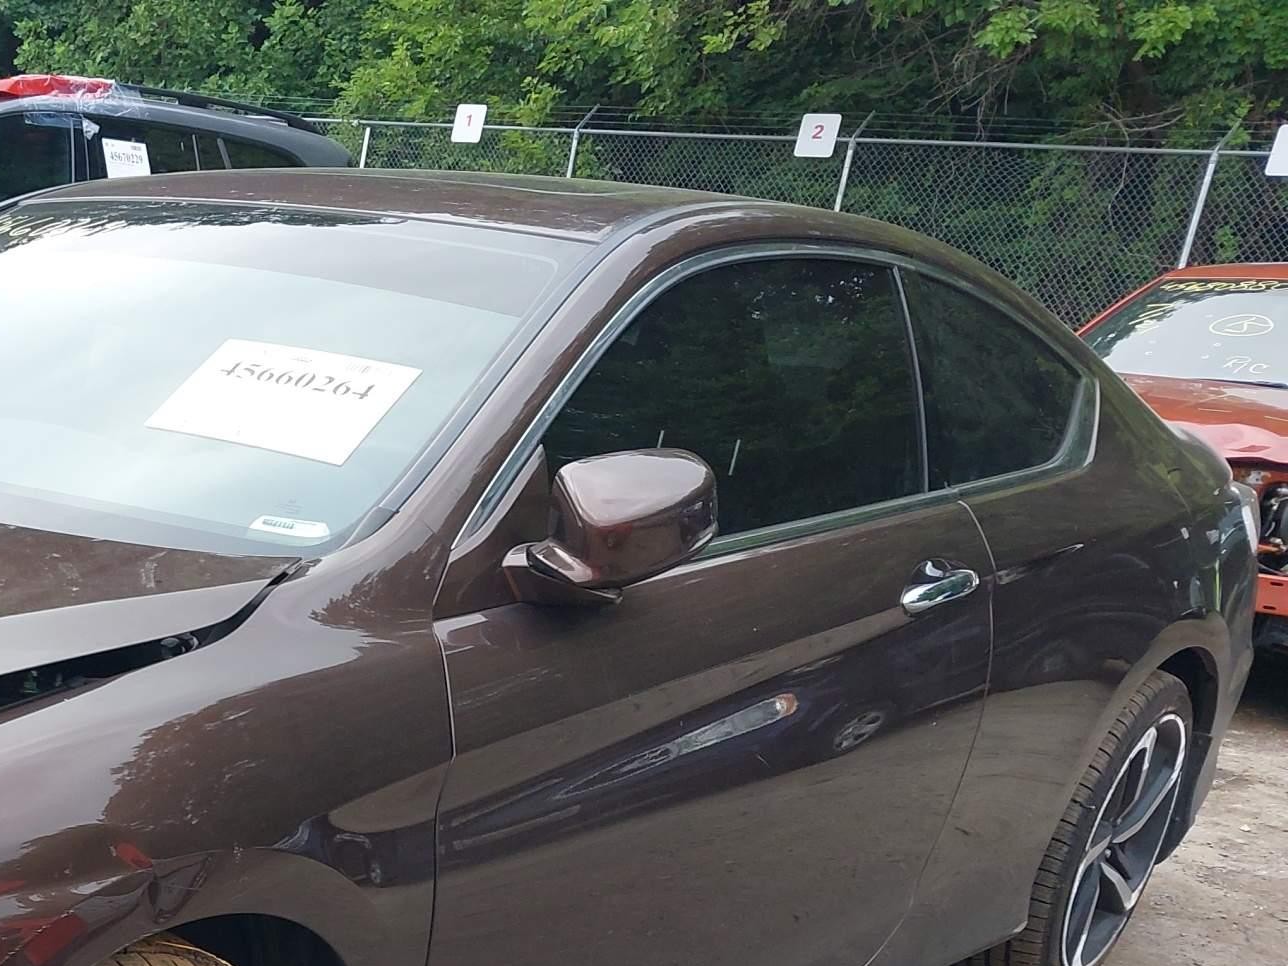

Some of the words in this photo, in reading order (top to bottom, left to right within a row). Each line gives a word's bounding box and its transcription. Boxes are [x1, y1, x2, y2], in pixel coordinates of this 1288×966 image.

[466, 114, 473, 127] 1
[811, 124, 825, 140] 2
[219, 360, 376, 400] 45660264
